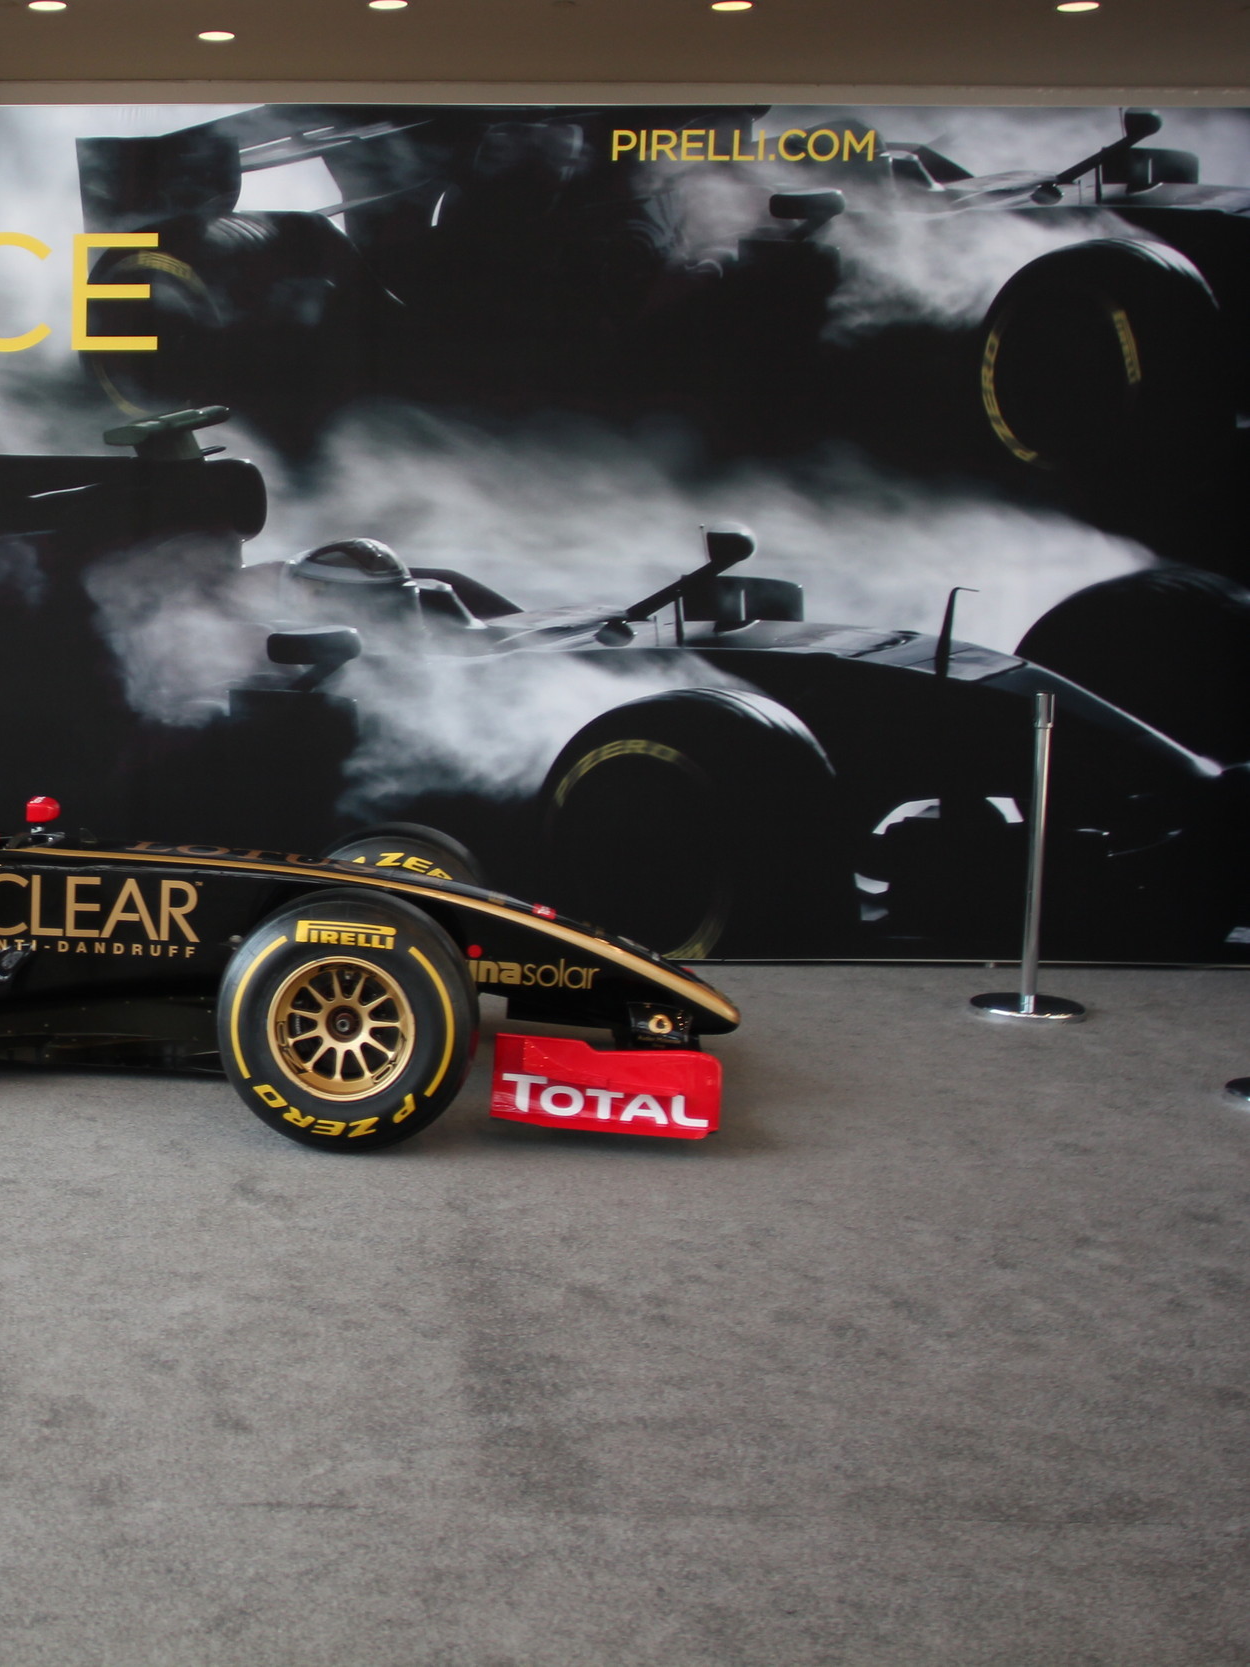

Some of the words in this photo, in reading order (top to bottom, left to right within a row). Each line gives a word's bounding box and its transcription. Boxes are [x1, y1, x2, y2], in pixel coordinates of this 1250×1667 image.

[611, 129, 875, 162] PIRELLI.COM
[295, 920, 397, 950] PIRELLI
[253, 1083, 380, 1138] ZERO
[392, 1093, 417, 1124] P
[502, 1073, 709, 1128] TOTAL
